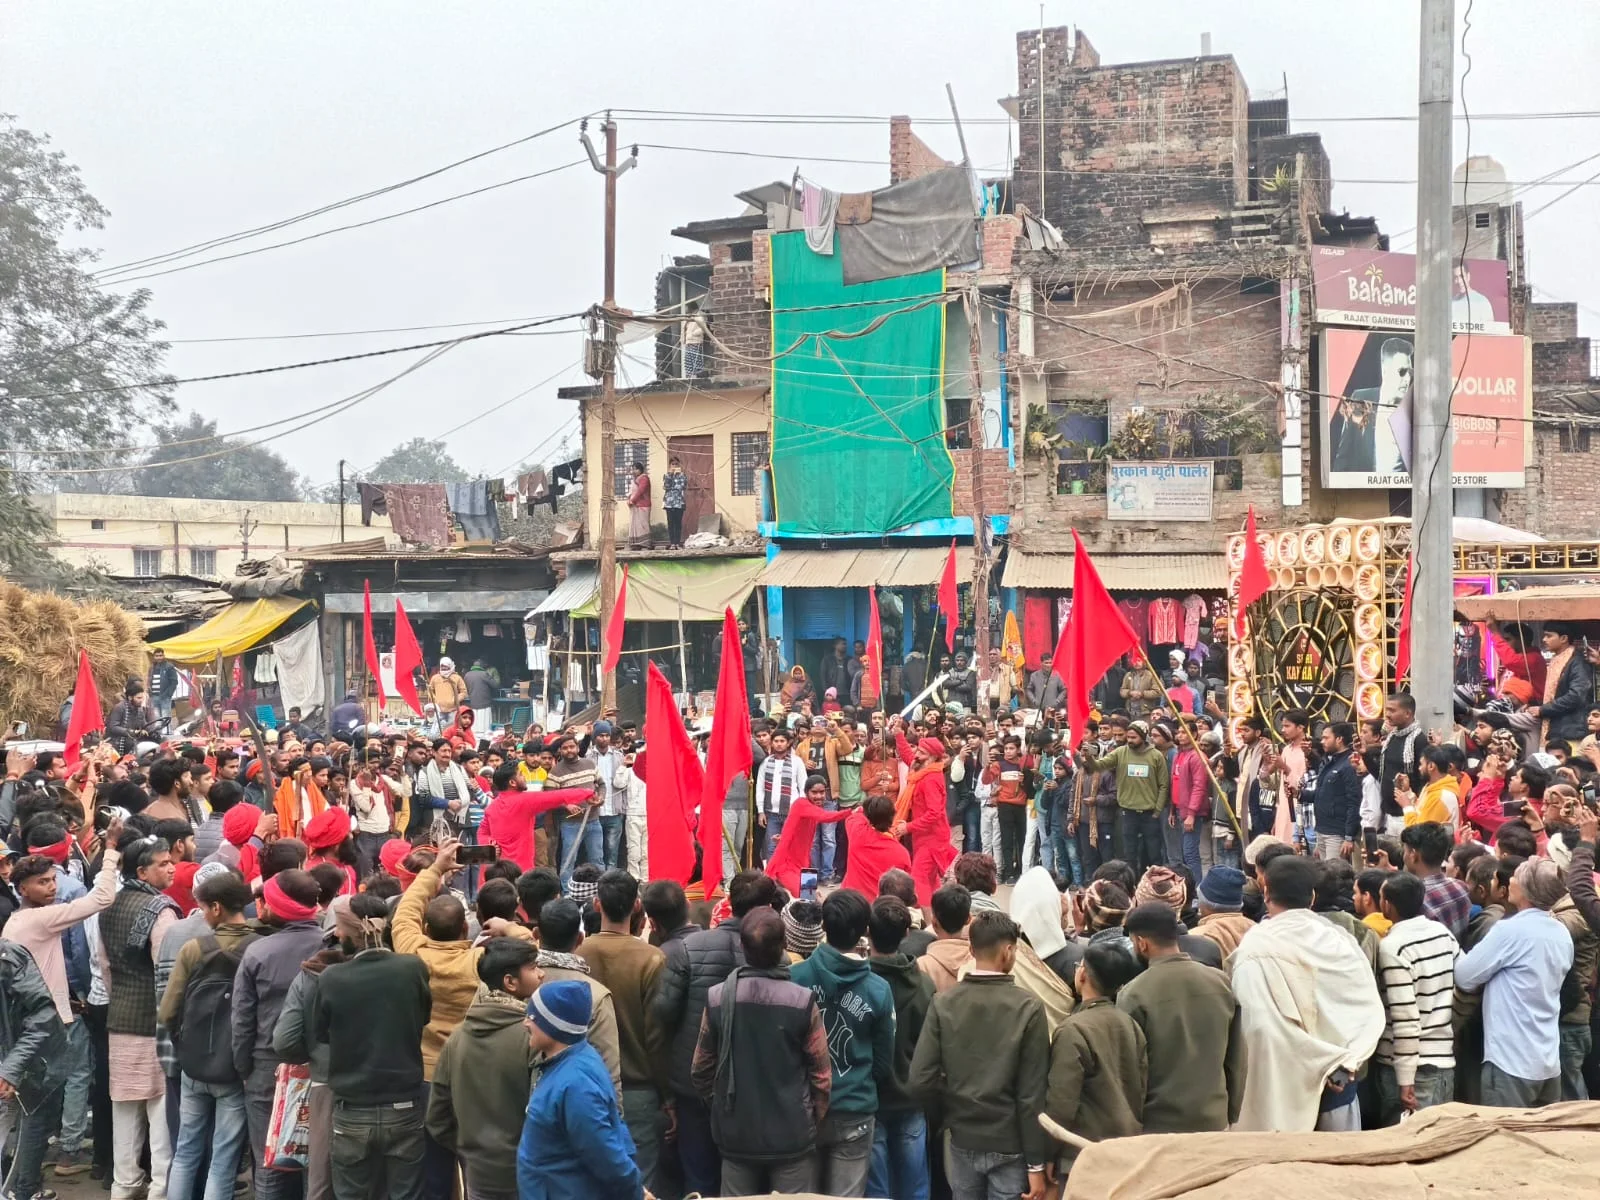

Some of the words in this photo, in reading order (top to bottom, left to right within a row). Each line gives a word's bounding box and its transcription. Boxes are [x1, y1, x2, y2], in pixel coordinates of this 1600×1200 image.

[1344, 314, 1369, 323] RAJAT
[1372, 315, 1415, 327] GARMENTS
[1460, 322, 1485, 331] STORE
[1452, 377, 1517, 395] DOLLAR
[1367, 475, 1392, 484] RAJAT
[1393, 475, 1412, 484] GAR
[1463, 475, 1488, 484] STORE
[840, 990, 873, 1022] ORK
